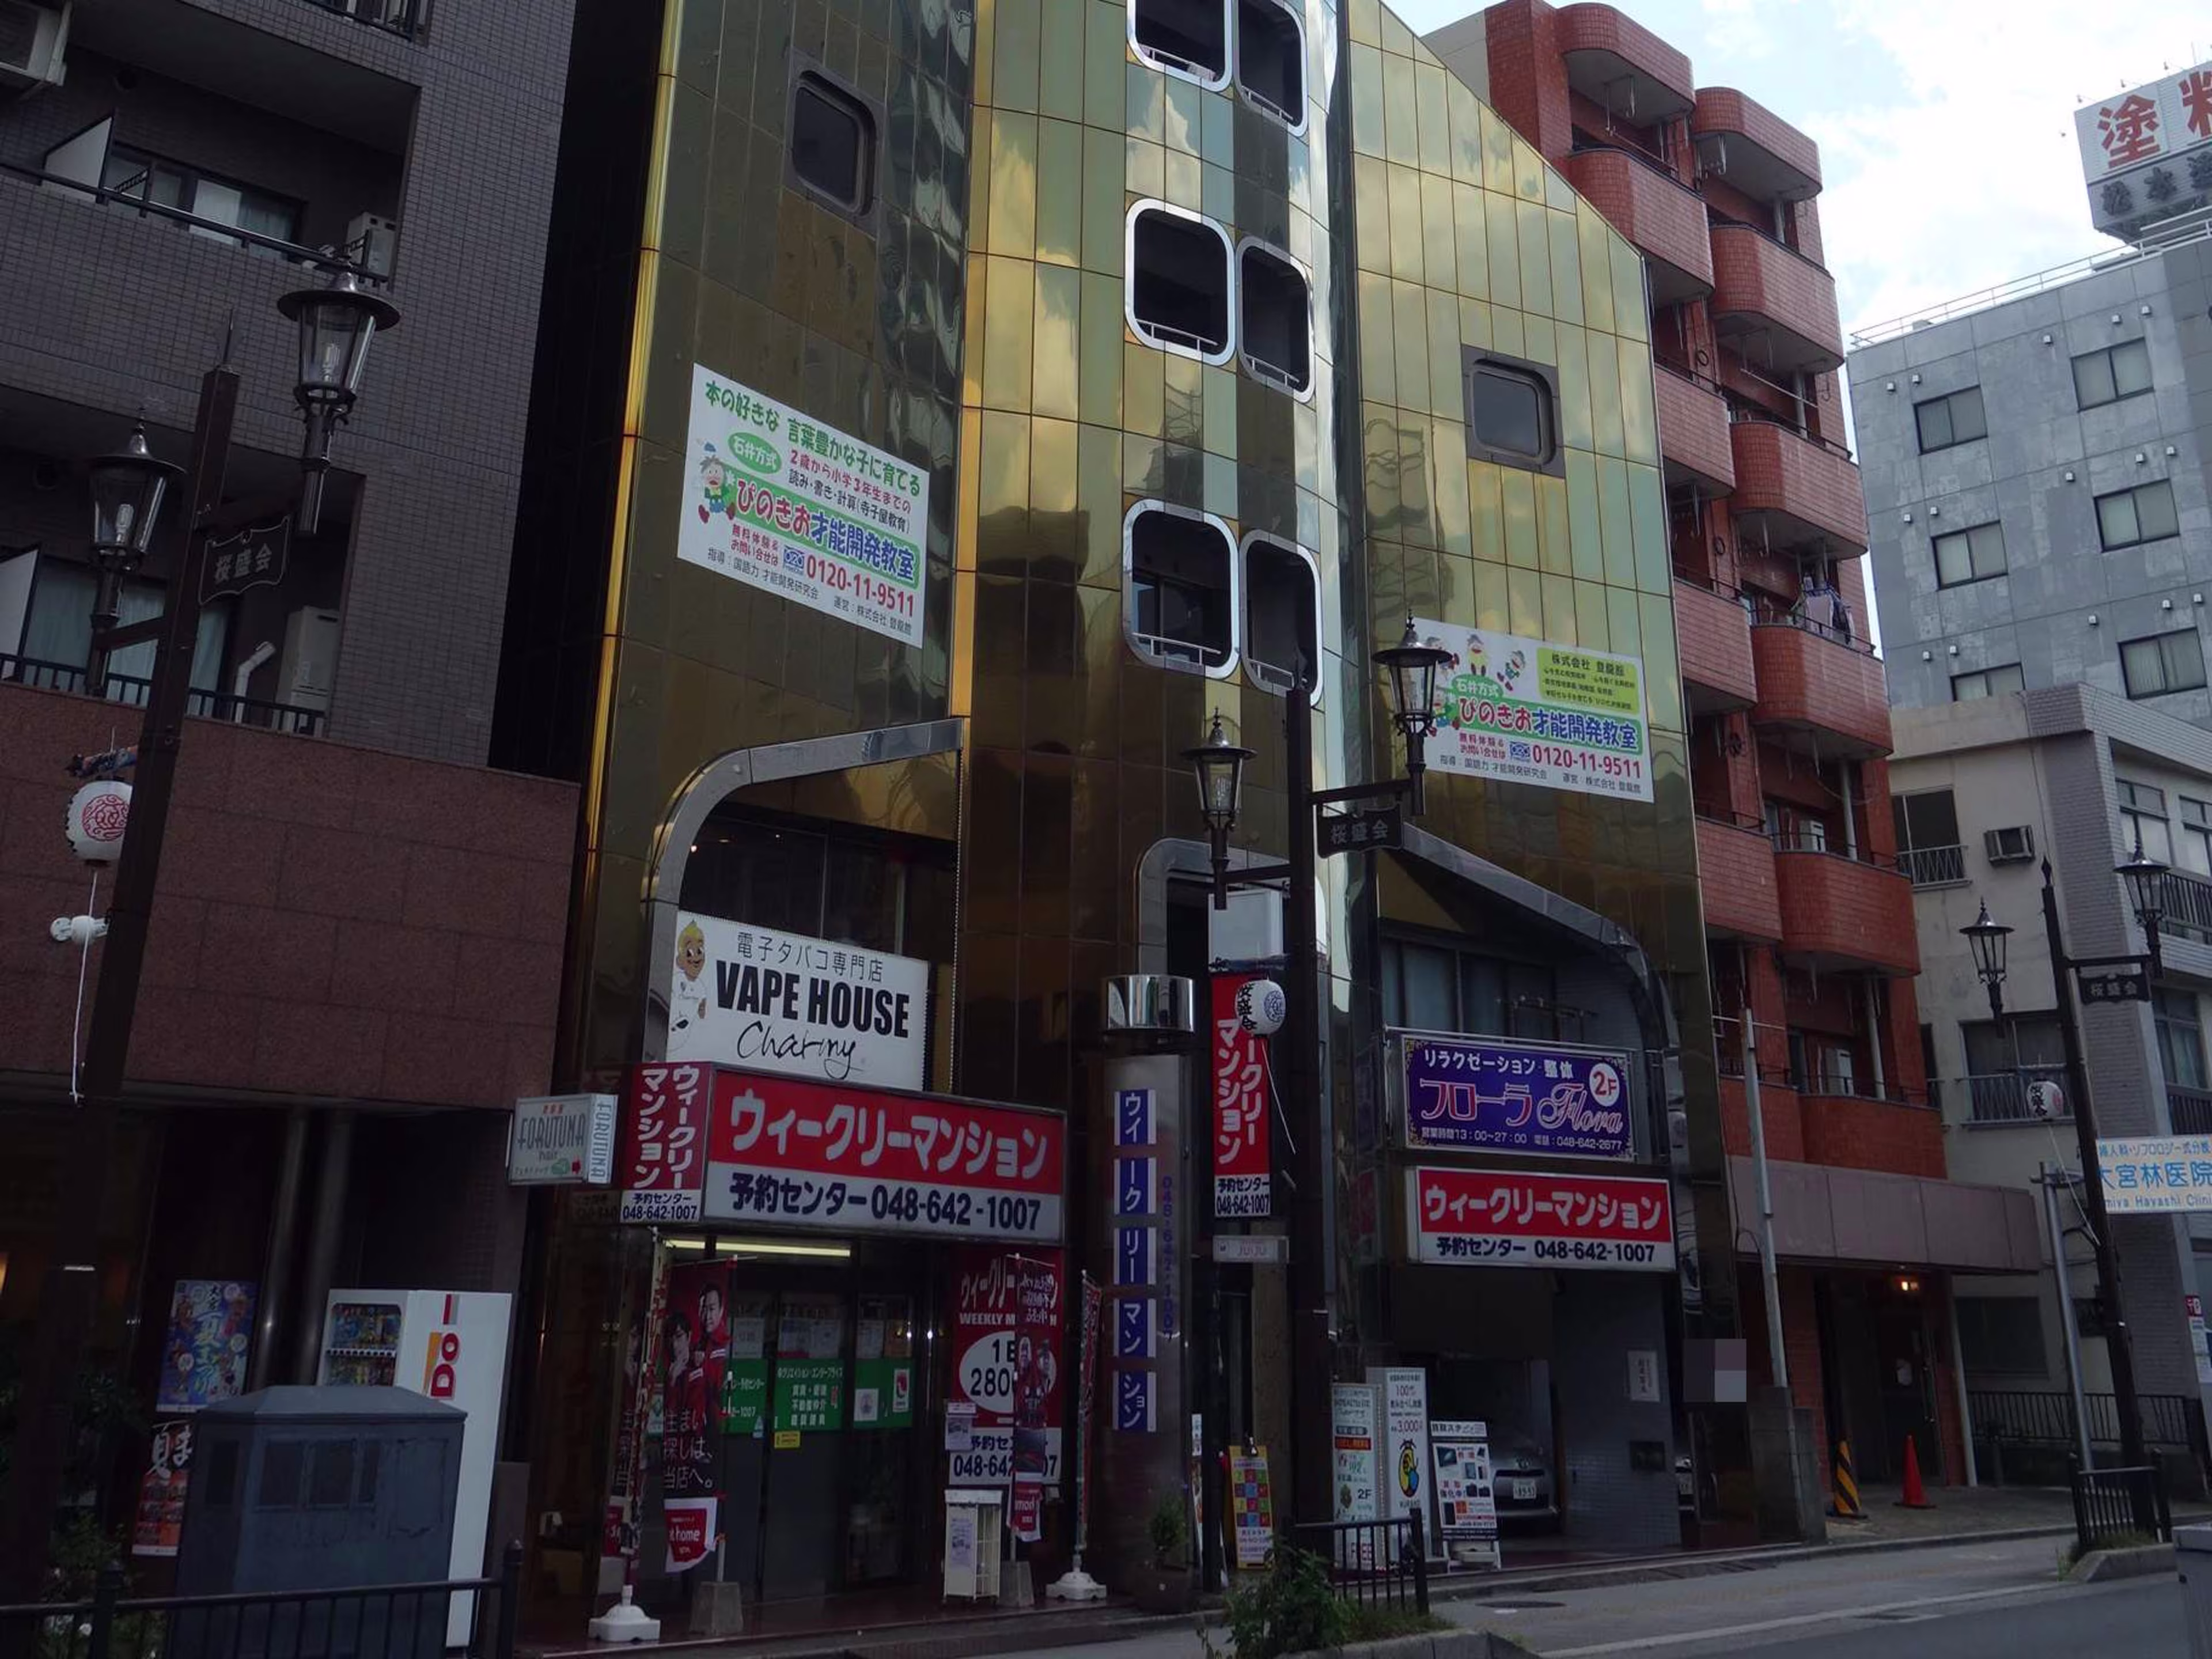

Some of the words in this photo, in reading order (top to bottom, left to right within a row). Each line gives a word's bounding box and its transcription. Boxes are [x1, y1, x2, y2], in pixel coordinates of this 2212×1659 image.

[706, 381, 779, 431] 本の好きな
[787, 418, 921, 497] 言葉豊かな子に育てる
[737, 478, 915, 581] ぴのきお才能開発教室
[806, 554, 914, 618] 0120-11-9511
[1459, 698, 1638, 750] ぴのきお才能開発教室
[1532, 744, 1641, 779] 0120-11-9511
[737, 931, 884, 983] 電子タバコ専門店
[716, 960, 801, 1020] VAPE
[808, 978, 911, 1039] HOUSE
[1217, 1018, 1243, 1165] マンション
[1419, 1078, 1533, 1127] フローラ
[1536, 1082, 1624, 1135] Flora
[1593, 1070, 1618, 1096] 2F
[632, 1069, 668, 1189] マンション
[730, 1089, 1048, 1180] ウィークリーマンション
[622, 1206, 698, 1220] 048-642-1007
[633, 1192, 692, 1205] 予約センター
[729, 1173, 868, 1216] 予約センター
[870, 1187, 1042, 1232] 048-642-1007
[1425, 1184, 1661, 1231] ウィークリーマンション
[1436, 1236, 1527, 1258] 予約センター
[1533, 1240, 1656, 1263] 048-642-1007
[959, 1312, 1003, 1325] WEEKLY
[970, 1368, 1016, 1396] 280
